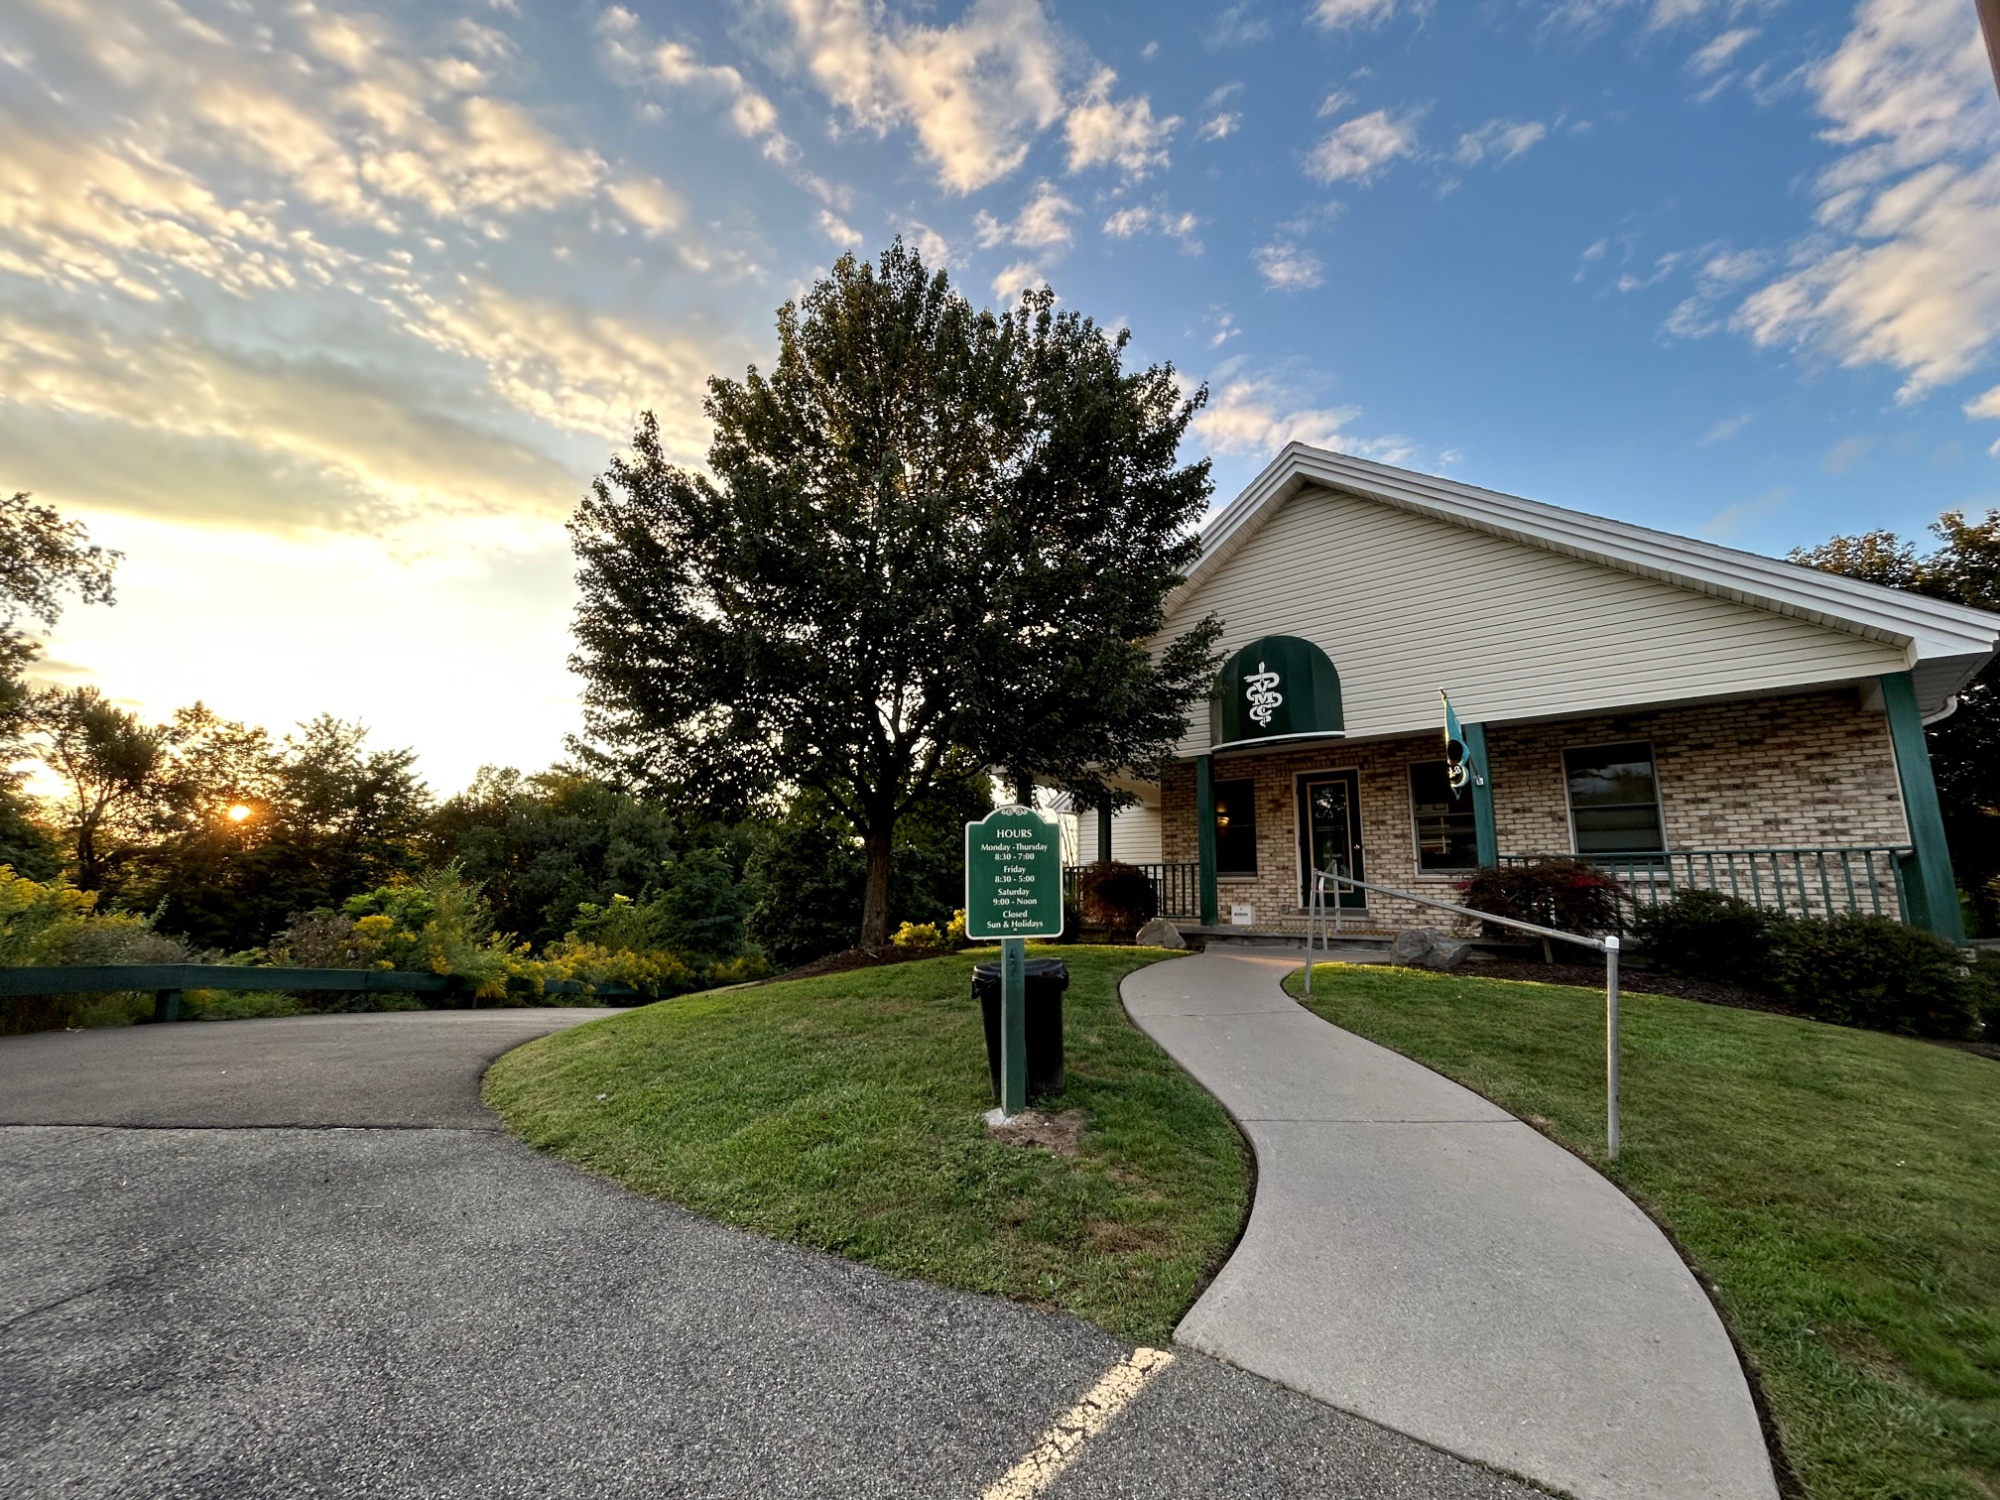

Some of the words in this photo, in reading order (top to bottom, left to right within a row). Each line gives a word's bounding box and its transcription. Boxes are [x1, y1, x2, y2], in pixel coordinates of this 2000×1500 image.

[997, 829, 1032, 838] HOURS
[981, 843, 1010, 852] Monday
[1003, 865, 1026, 874] Friday
[998, 888, 1029, 897] Saturday
[1003, 910, 1027, 918] Closed
[1011, 920, 1043, 929] Holidays
